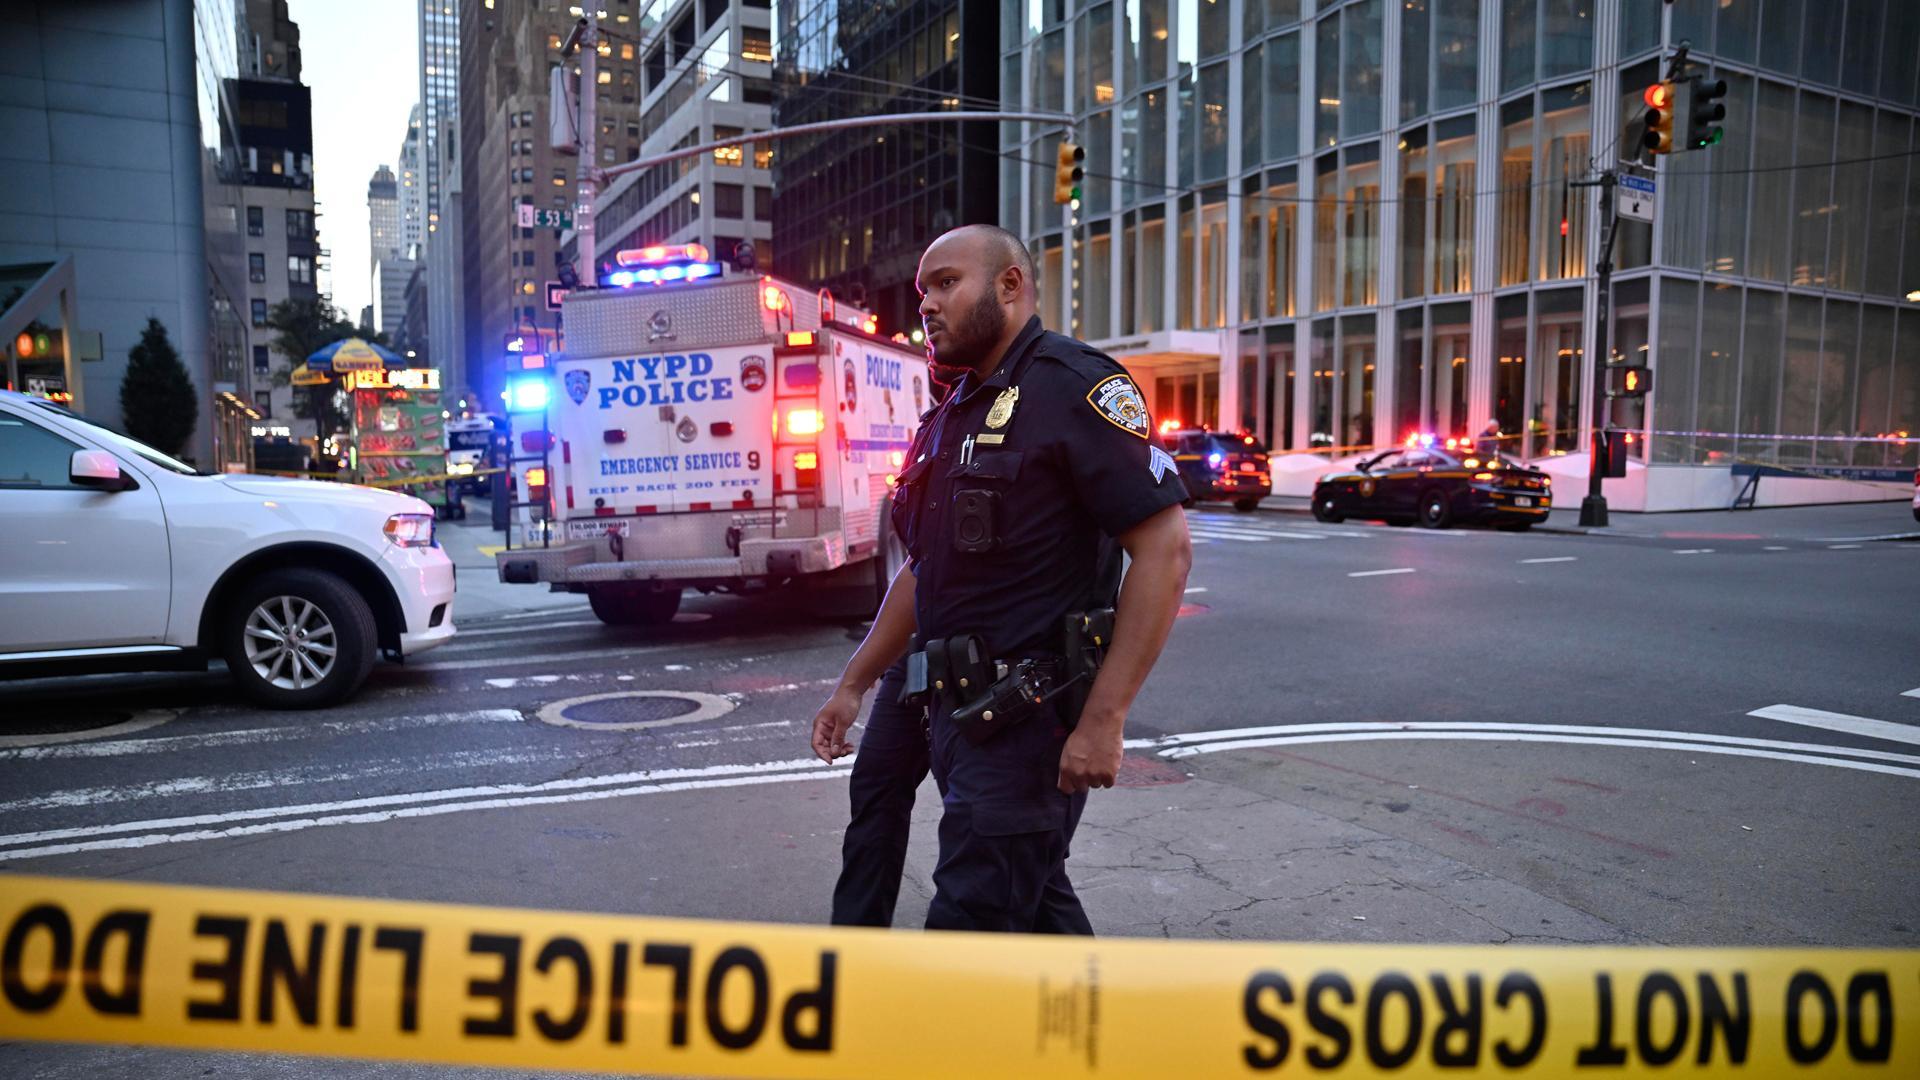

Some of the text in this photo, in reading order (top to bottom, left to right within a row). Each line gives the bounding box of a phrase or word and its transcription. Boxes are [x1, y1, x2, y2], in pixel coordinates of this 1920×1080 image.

[534, 209, 541, 225] E
[546, 210, 560, 227] 53
[612, 353, 713, 383] NYPD
[866, 354, 902, 391] POLICE
[598, 377, 733, 409] POLICE
[1100, 379, 1123, 395] POLICE
[1108, 412, 1126, 425] CITY
[601, 451, 760, 476] EMERGENCY SERVICE 9
[589, 479, 761, 495] KEEP BACK 200 FEET
[0, 902, 838, 1053] POLICE LINE DO
[1242, 969, 1898, 1072] DO NOT CROSS
